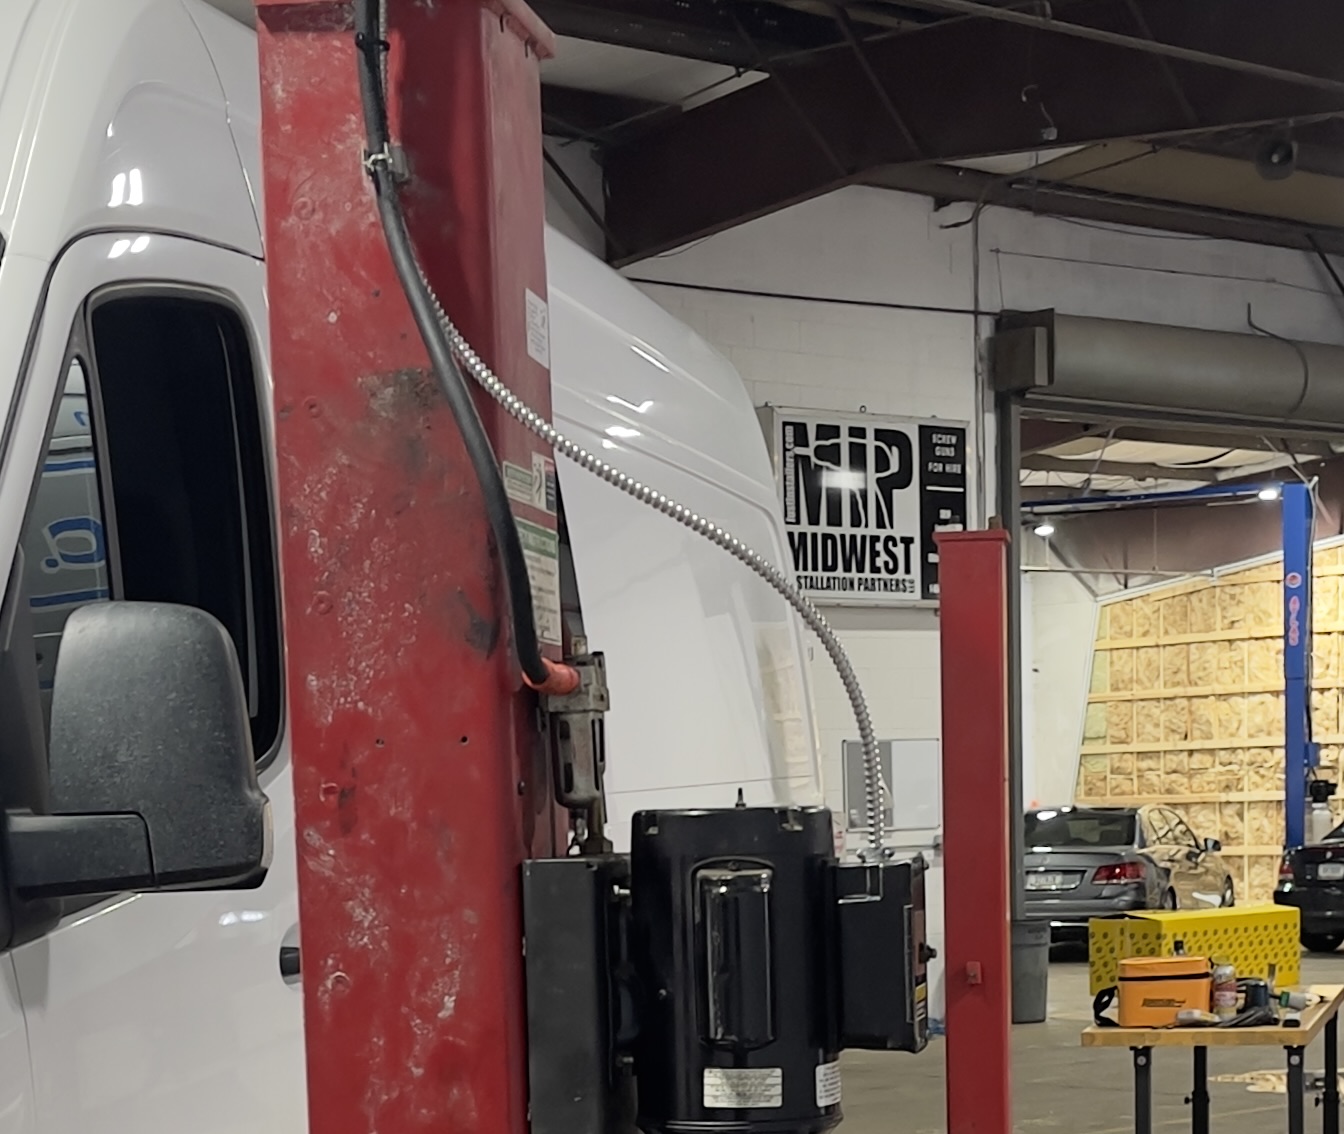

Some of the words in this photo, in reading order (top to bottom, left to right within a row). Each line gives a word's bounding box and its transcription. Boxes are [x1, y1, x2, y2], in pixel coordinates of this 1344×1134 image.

[932, 433, 957, 445] SCREW
[928, 462, 943, 473] FOR
[945, 463, 962, 474] HIRE
[787, 531, 914, 575] MIDWEST
[796, 576, 855, 591] STALLATION
[857, 577, 907, 593] PARTNERS
